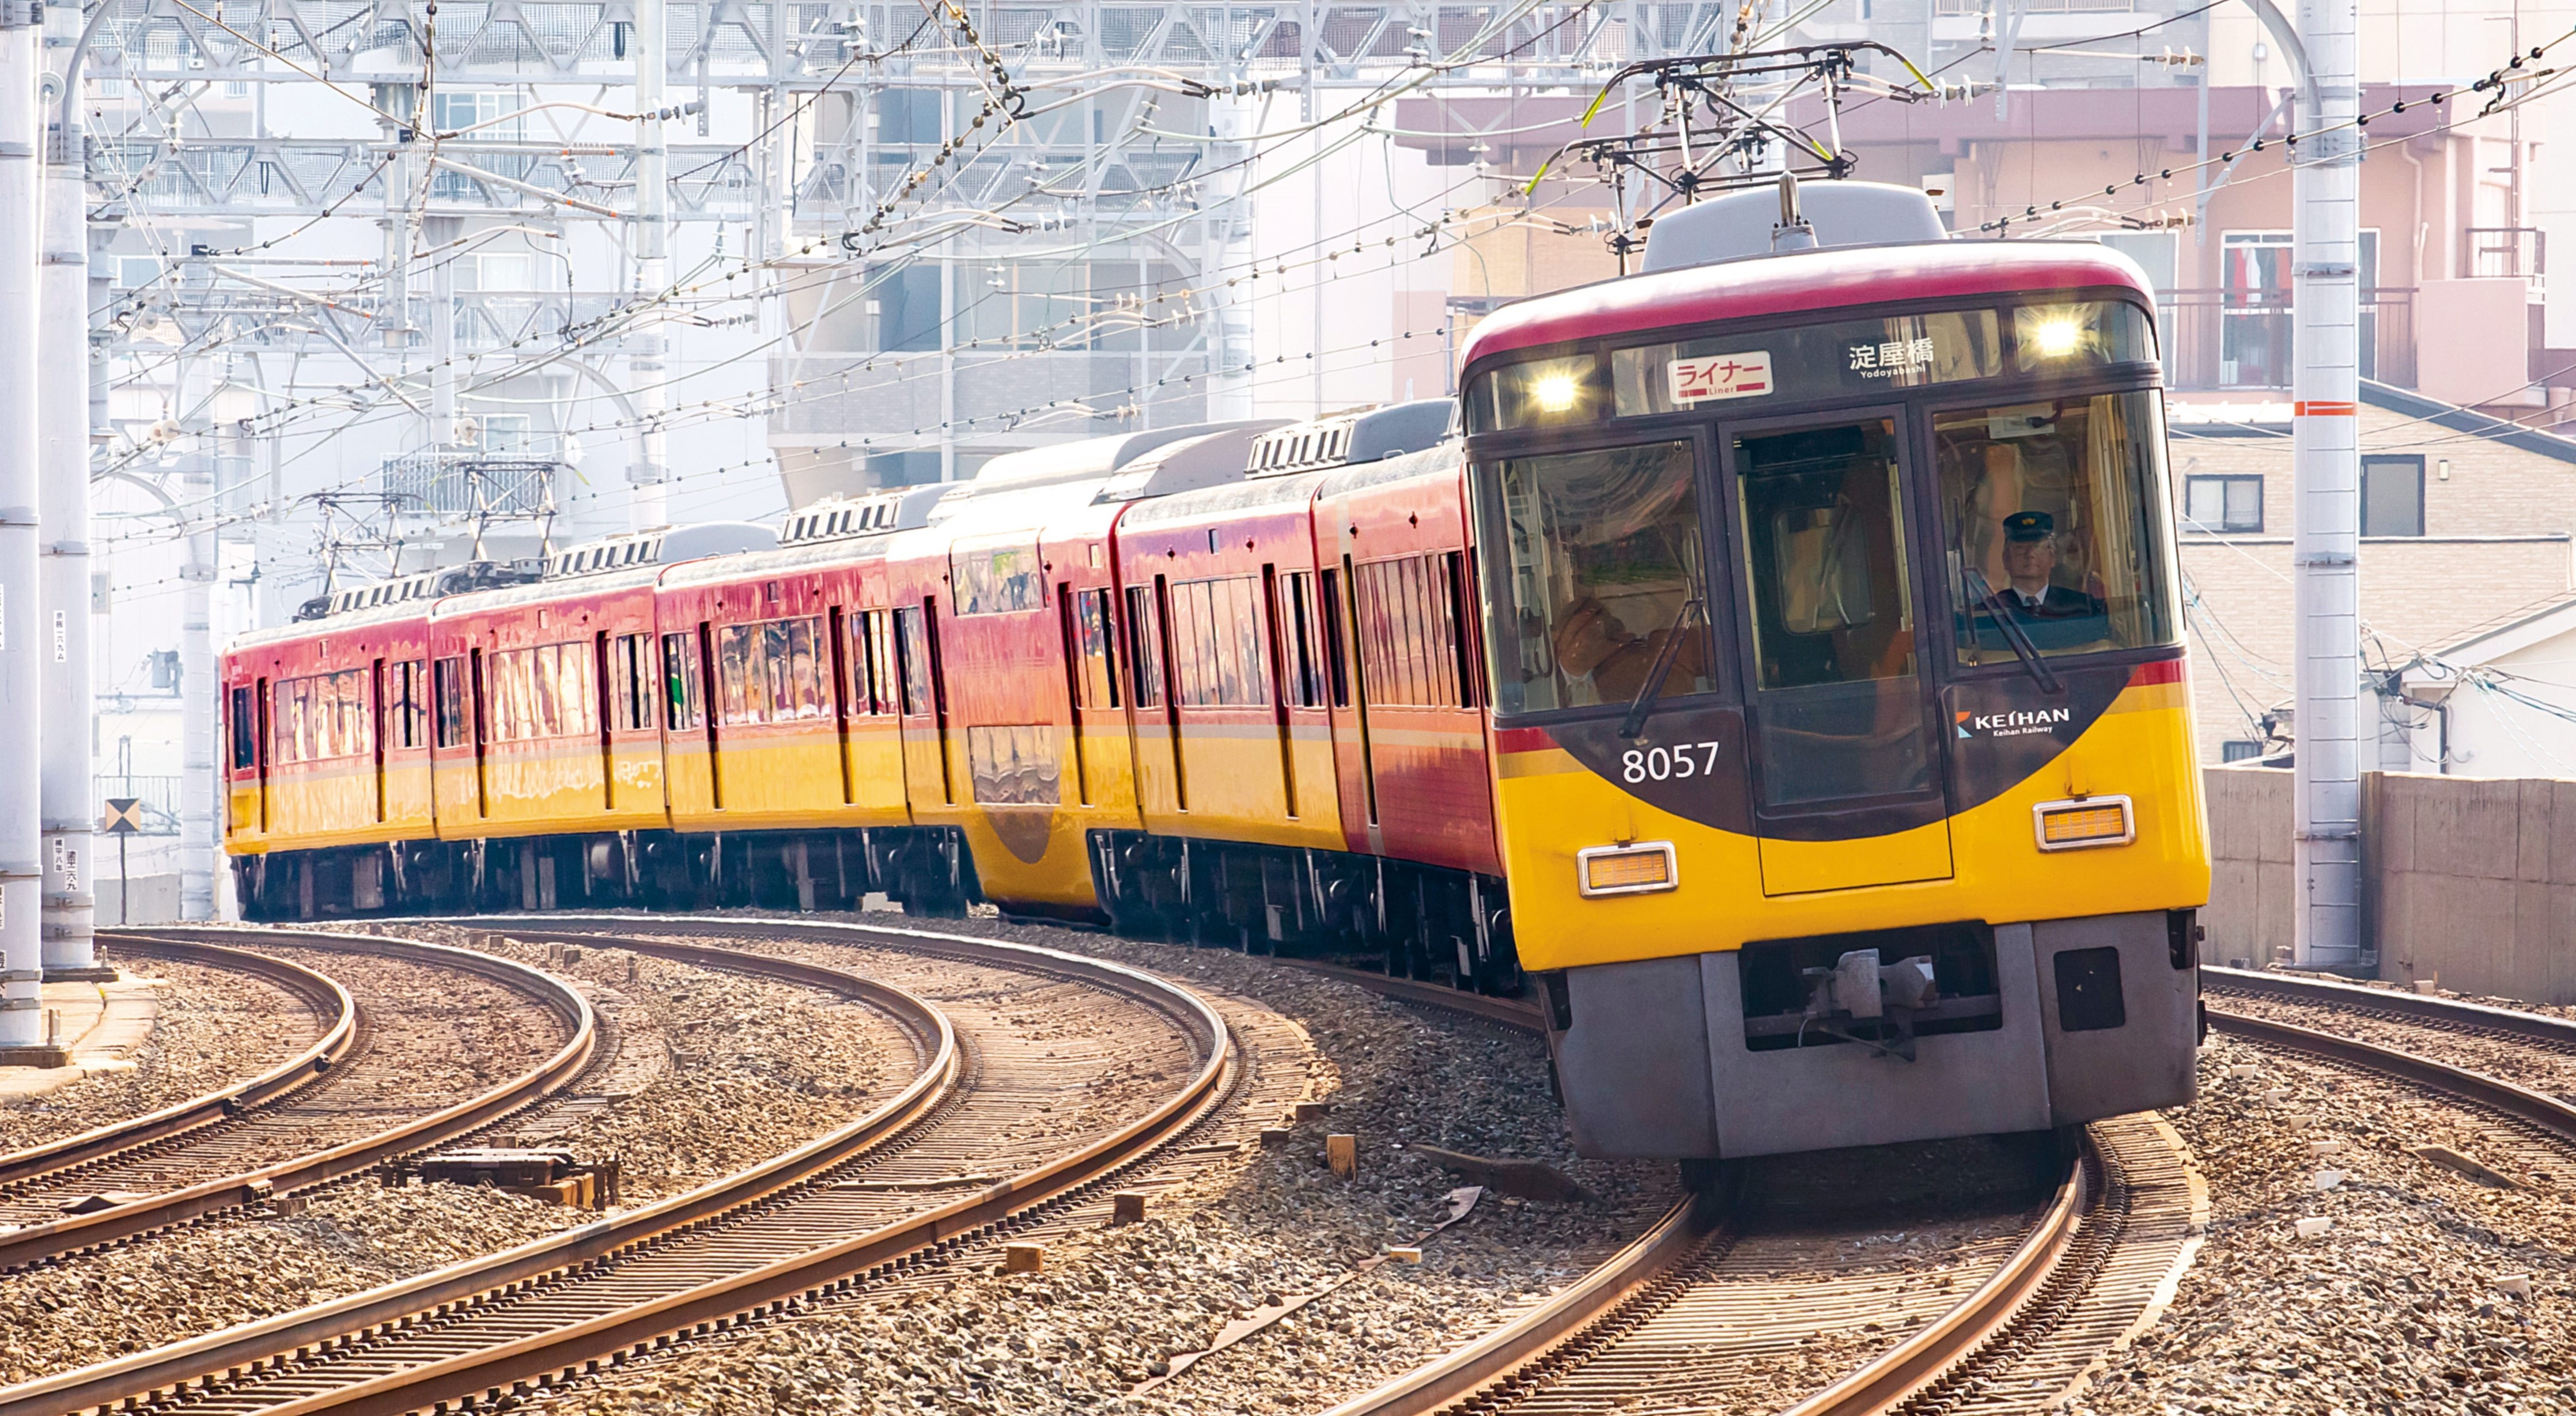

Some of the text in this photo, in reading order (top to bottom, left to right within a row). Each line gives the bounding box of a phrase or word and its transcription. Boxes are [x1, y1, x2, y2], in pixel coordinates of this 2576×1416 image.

[1849, 337, 1934, 370] 淀屋橋
[1677, 361, 1764, 387] ライナー
[1860, 364, 1926, 378] Yodoyabashi
[1708, 387, 1734, 395] Liner
[1975, 708, 2070, 730] KEIHAN
[2022, 726, 2053, 734] Railway
[1622, 741, 1719, 783] 8057
